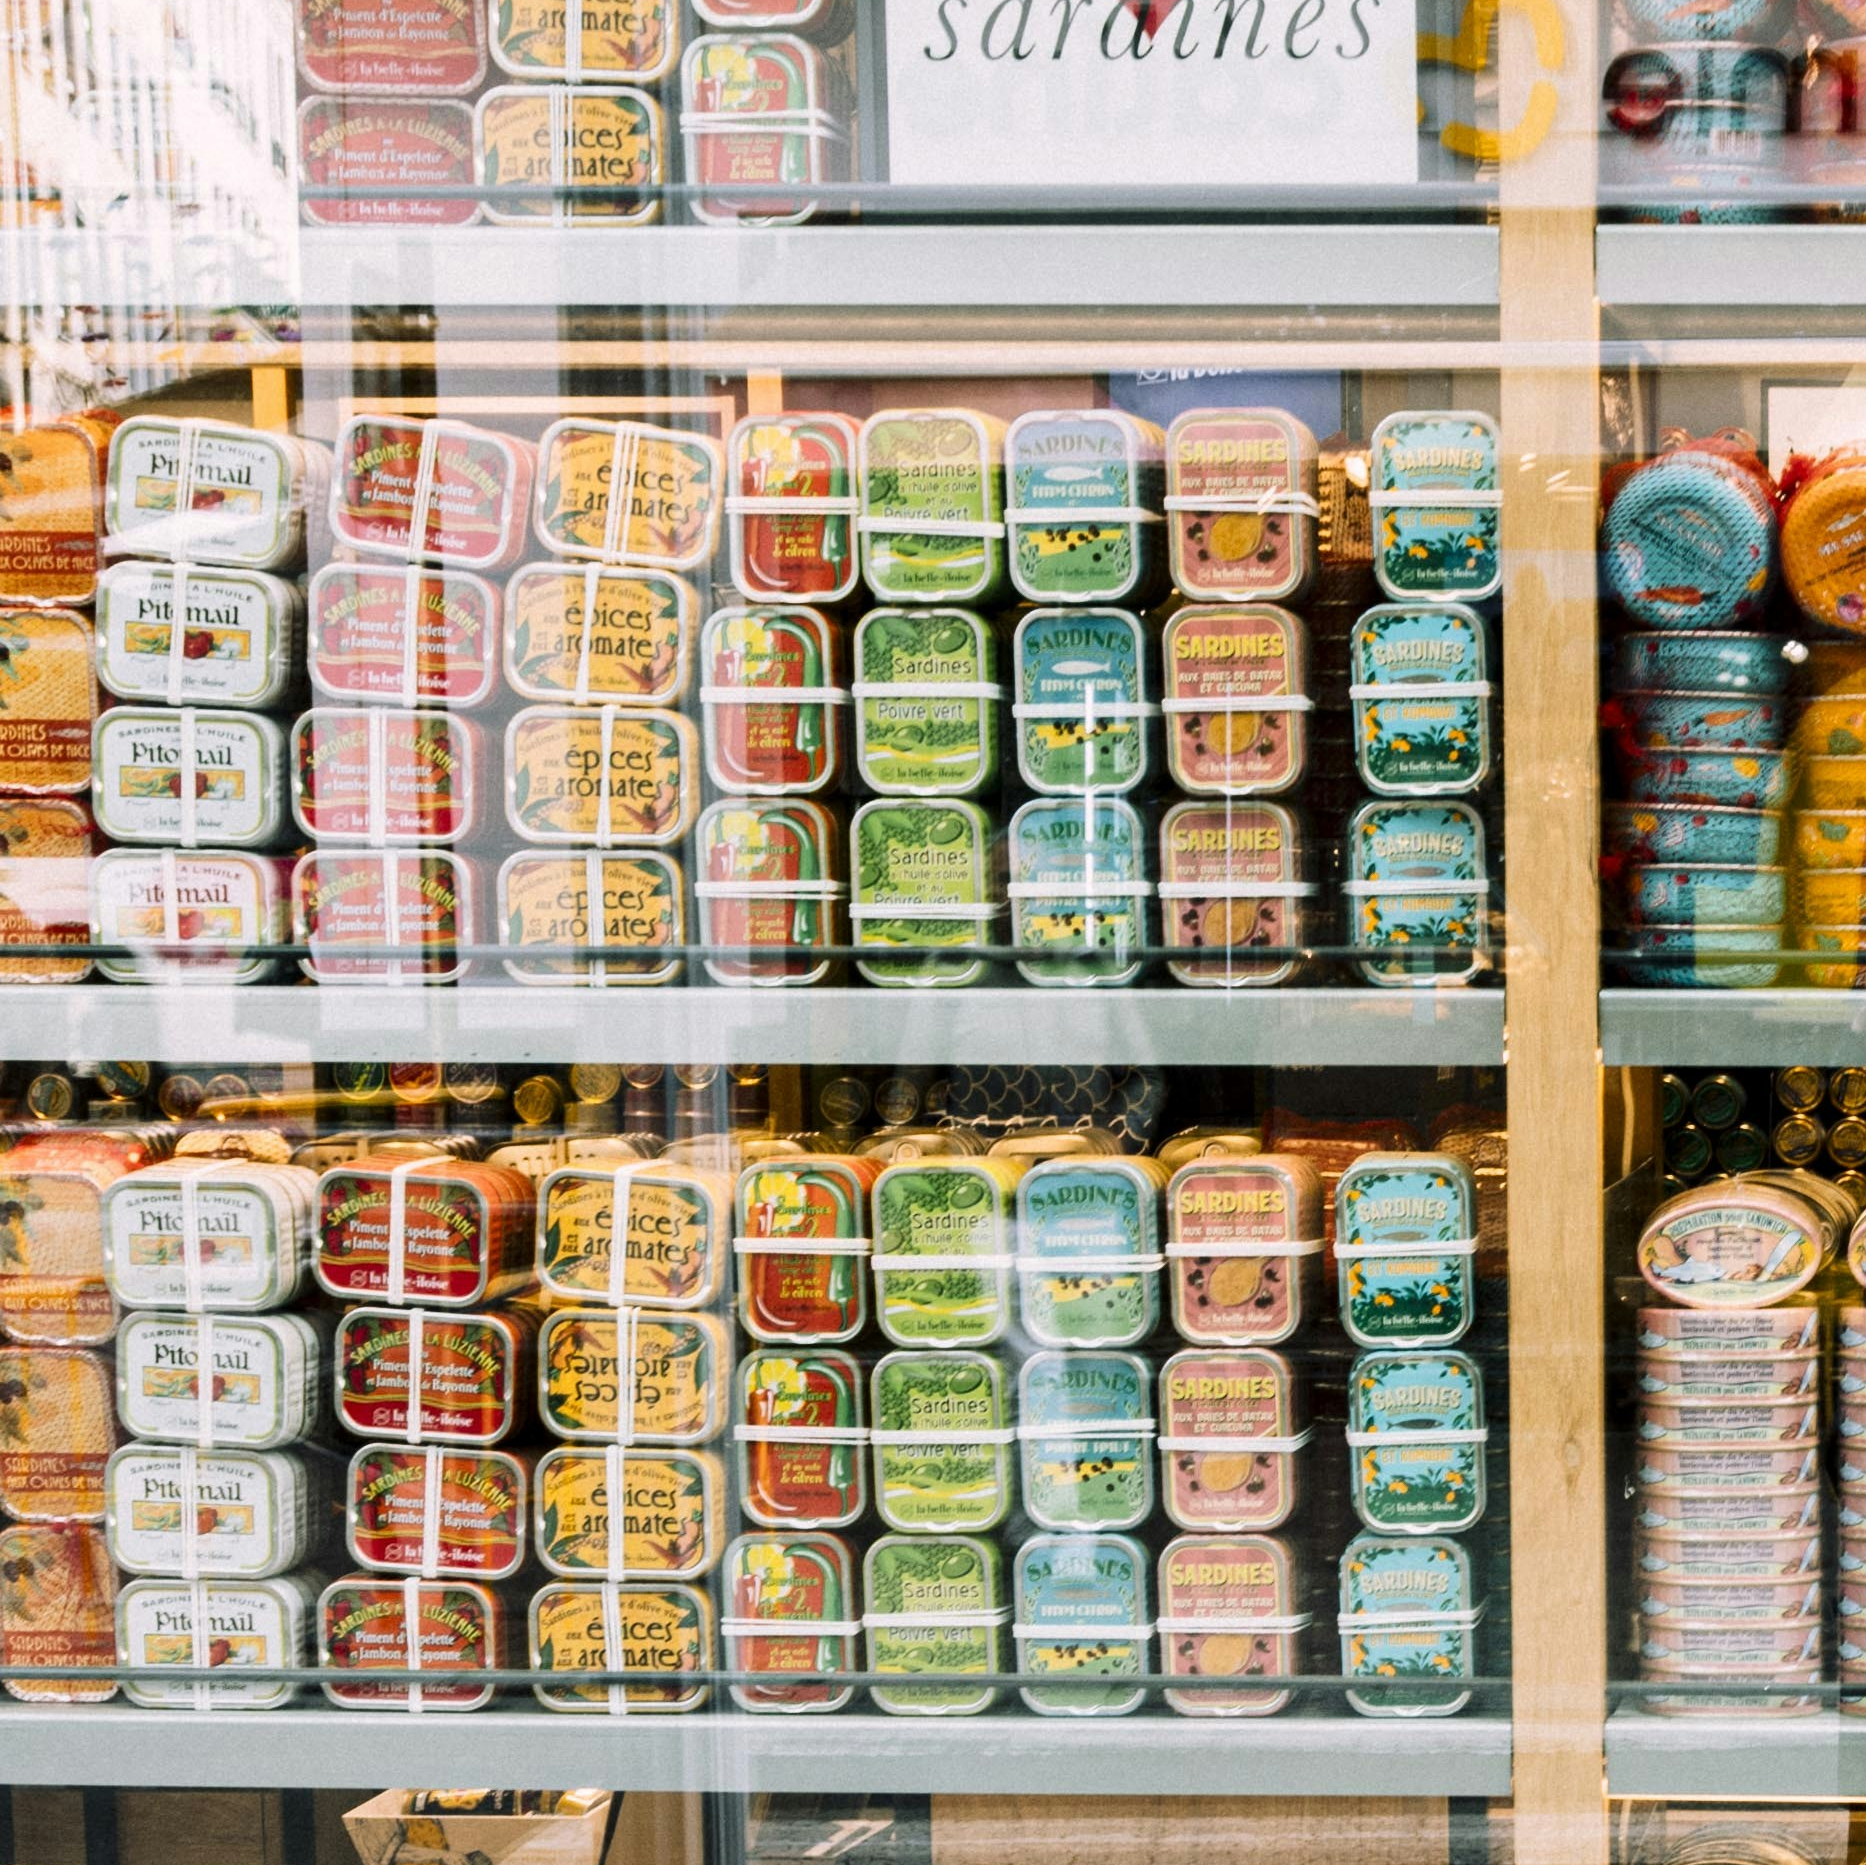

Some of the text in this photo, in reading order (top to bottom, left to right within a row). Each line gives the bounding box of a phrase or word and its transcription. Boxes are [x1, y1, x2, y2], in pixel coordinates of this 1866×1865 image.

[349, 444, 413, 476] SARDINES
[1179, 439, 1287, 463] SARDINES
[1394, 447, 1482, 472] SARDINES
[150, 453, 251, 485] Pitmaïl
[899, 461, 977, 478] Sardines
[139, 599, 240, 625] Pitmaïl
[1177, 635, 1284, 660] SARDINES
[1375, 641, 1463, 666] SARDINES
[895, 657, 971, 674] Sardines
[879, 703, 964, 720] Poivre vert
[564, 745, 652, 775] épces
[1172, 827, 1280, 853] SARDINES
[1375, 834, 1464, 858] SARDINES
[890, 847, 967, 866] Sardines
[556, 886, 645, 911] épces
[551, 917, 656, 938] aroates
[1030, 1186, 1136, 1211] SARDINES
[1181, 1191, 1284, 1214] SARDINES
[326, 1192, 477, 1238] SARDINES LUZIENNE
[912, 1213, 989, 1230] Sardines
[1358, 1199, 1448, 1222] SARDINES
[350, 1221, 388, 1235] Piment
[408, 1241, 456, 1257] Bayonne
[350, 1331, 409, 1365] SARDINES
[443, 1334, 500, 1376] LUZIENNE
[432, 1380, 479, 1394] Bayonne
[1173, 1377, 1275, 1401] SARDINES
[1372, 1386, 1461, 1409] SARDINES
[912, 1398, 988, 1414] Sardines
[363, 1466, 515, 1512] SARDINES LUZIENNE
[591, 1484, 676, 1507] éices
[444, 1515, 492, 1530] Bayonne
[1172, 1563, 1273, 1586] SARDINES
[1362, 1570, 1449, 1593] SARDINES
[904, 1583, 978, 1598] Sardines
[333, 1601, 482, 1644] SARDINES LUZIENNE
[587, 1618, 672, 1642] éices
[889, 1626, 971, 1641] Poivre vert
